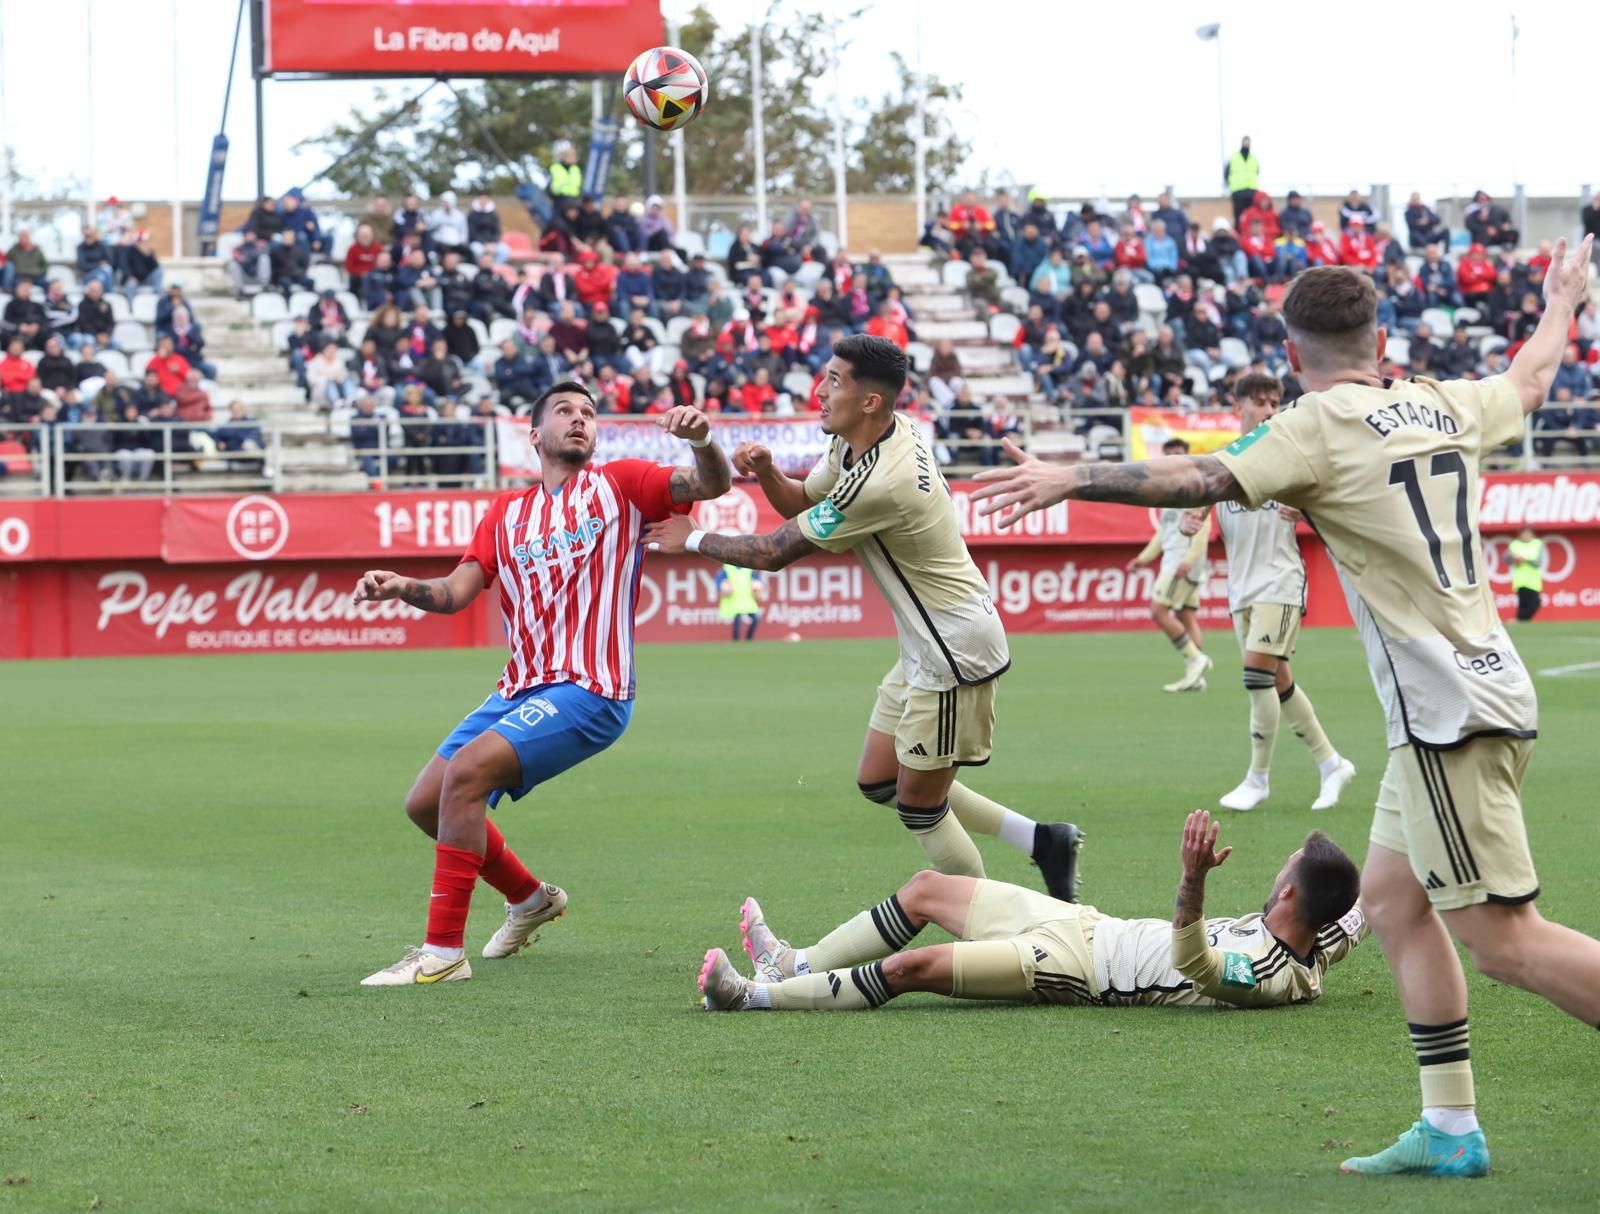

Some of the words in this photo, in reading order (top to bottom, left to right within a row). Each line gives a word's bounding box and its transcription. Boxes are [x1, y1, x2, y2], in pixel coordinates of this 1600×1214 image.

[374, 27, 405, 51] La
[408, 27, 469, 51] Fibra
[472, 28, 503, 52] de
[505, 27, 561, 57] Aquí
[1365, 401, 1458, 437] ESTACIO
[951, 491, 1068, 536] RACION
[1388, 451, 1476, 589] 17
[1479, 475, 1600, 523] avaho
[515, 518, 603, 565] SCAMP
[97, 571, 217, 639] Pepe
[666, 567, 863, 602] HYNDAI
[986, 561, 1156, 615] lgetran
[187, 630, 270, 648] BOUTIQUE
[273, 629, 298, 646] DE
[299, 626, 407, 646] CABALLEROS
[766, 602, 863, 627] Algeciras
